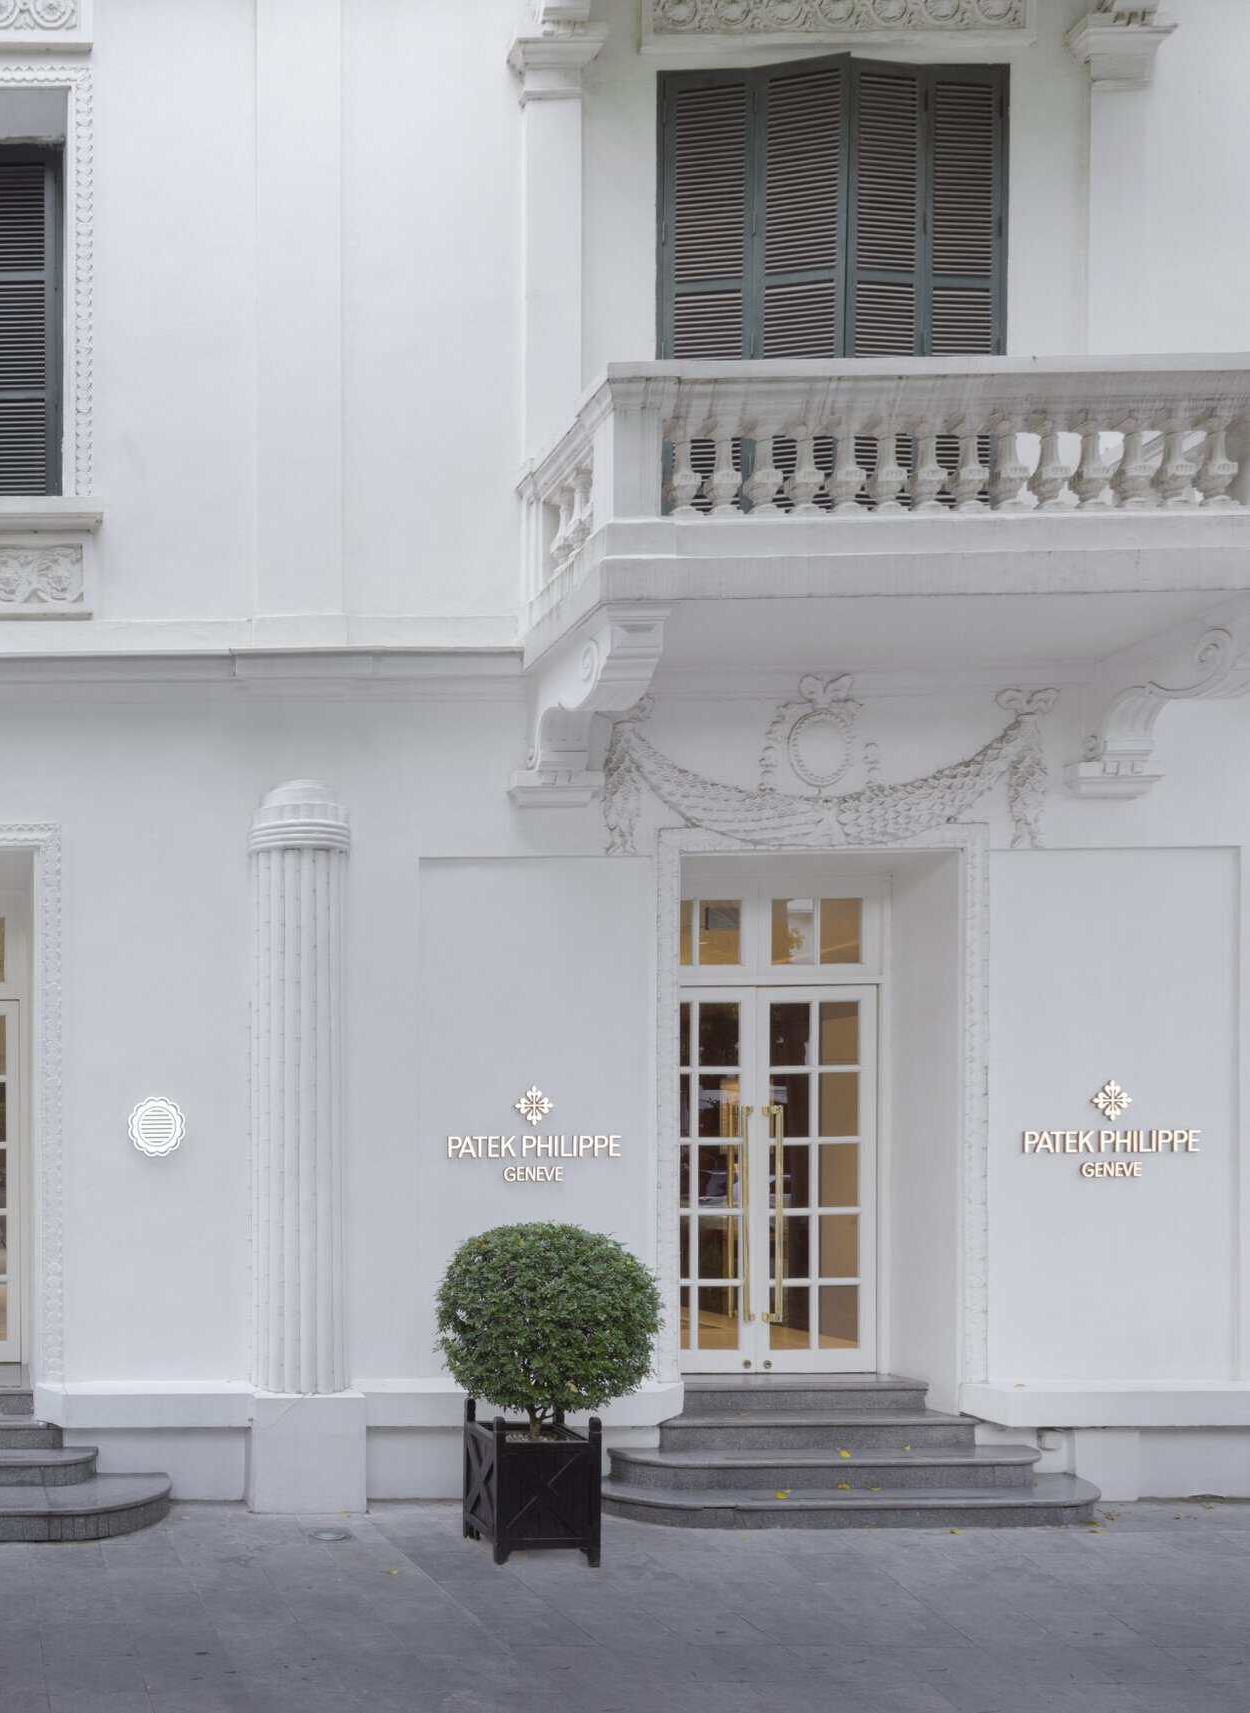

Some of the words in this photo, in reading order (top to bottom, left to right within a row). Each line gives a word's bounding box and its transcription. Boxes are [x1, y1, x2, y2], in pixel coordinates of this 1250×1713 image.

[447, 1135, 517, 1159] PATEK
[521, 1134, 623, 1158] PHILIPPE
[1023, 1130, 1095, 1154] PATEK
[1099, 1129, 1202, 1153] PHILIPPE
[503, 1166, 564, 1183] GENEVE
[1081, 1161, 1143, 1178] GENEVE
